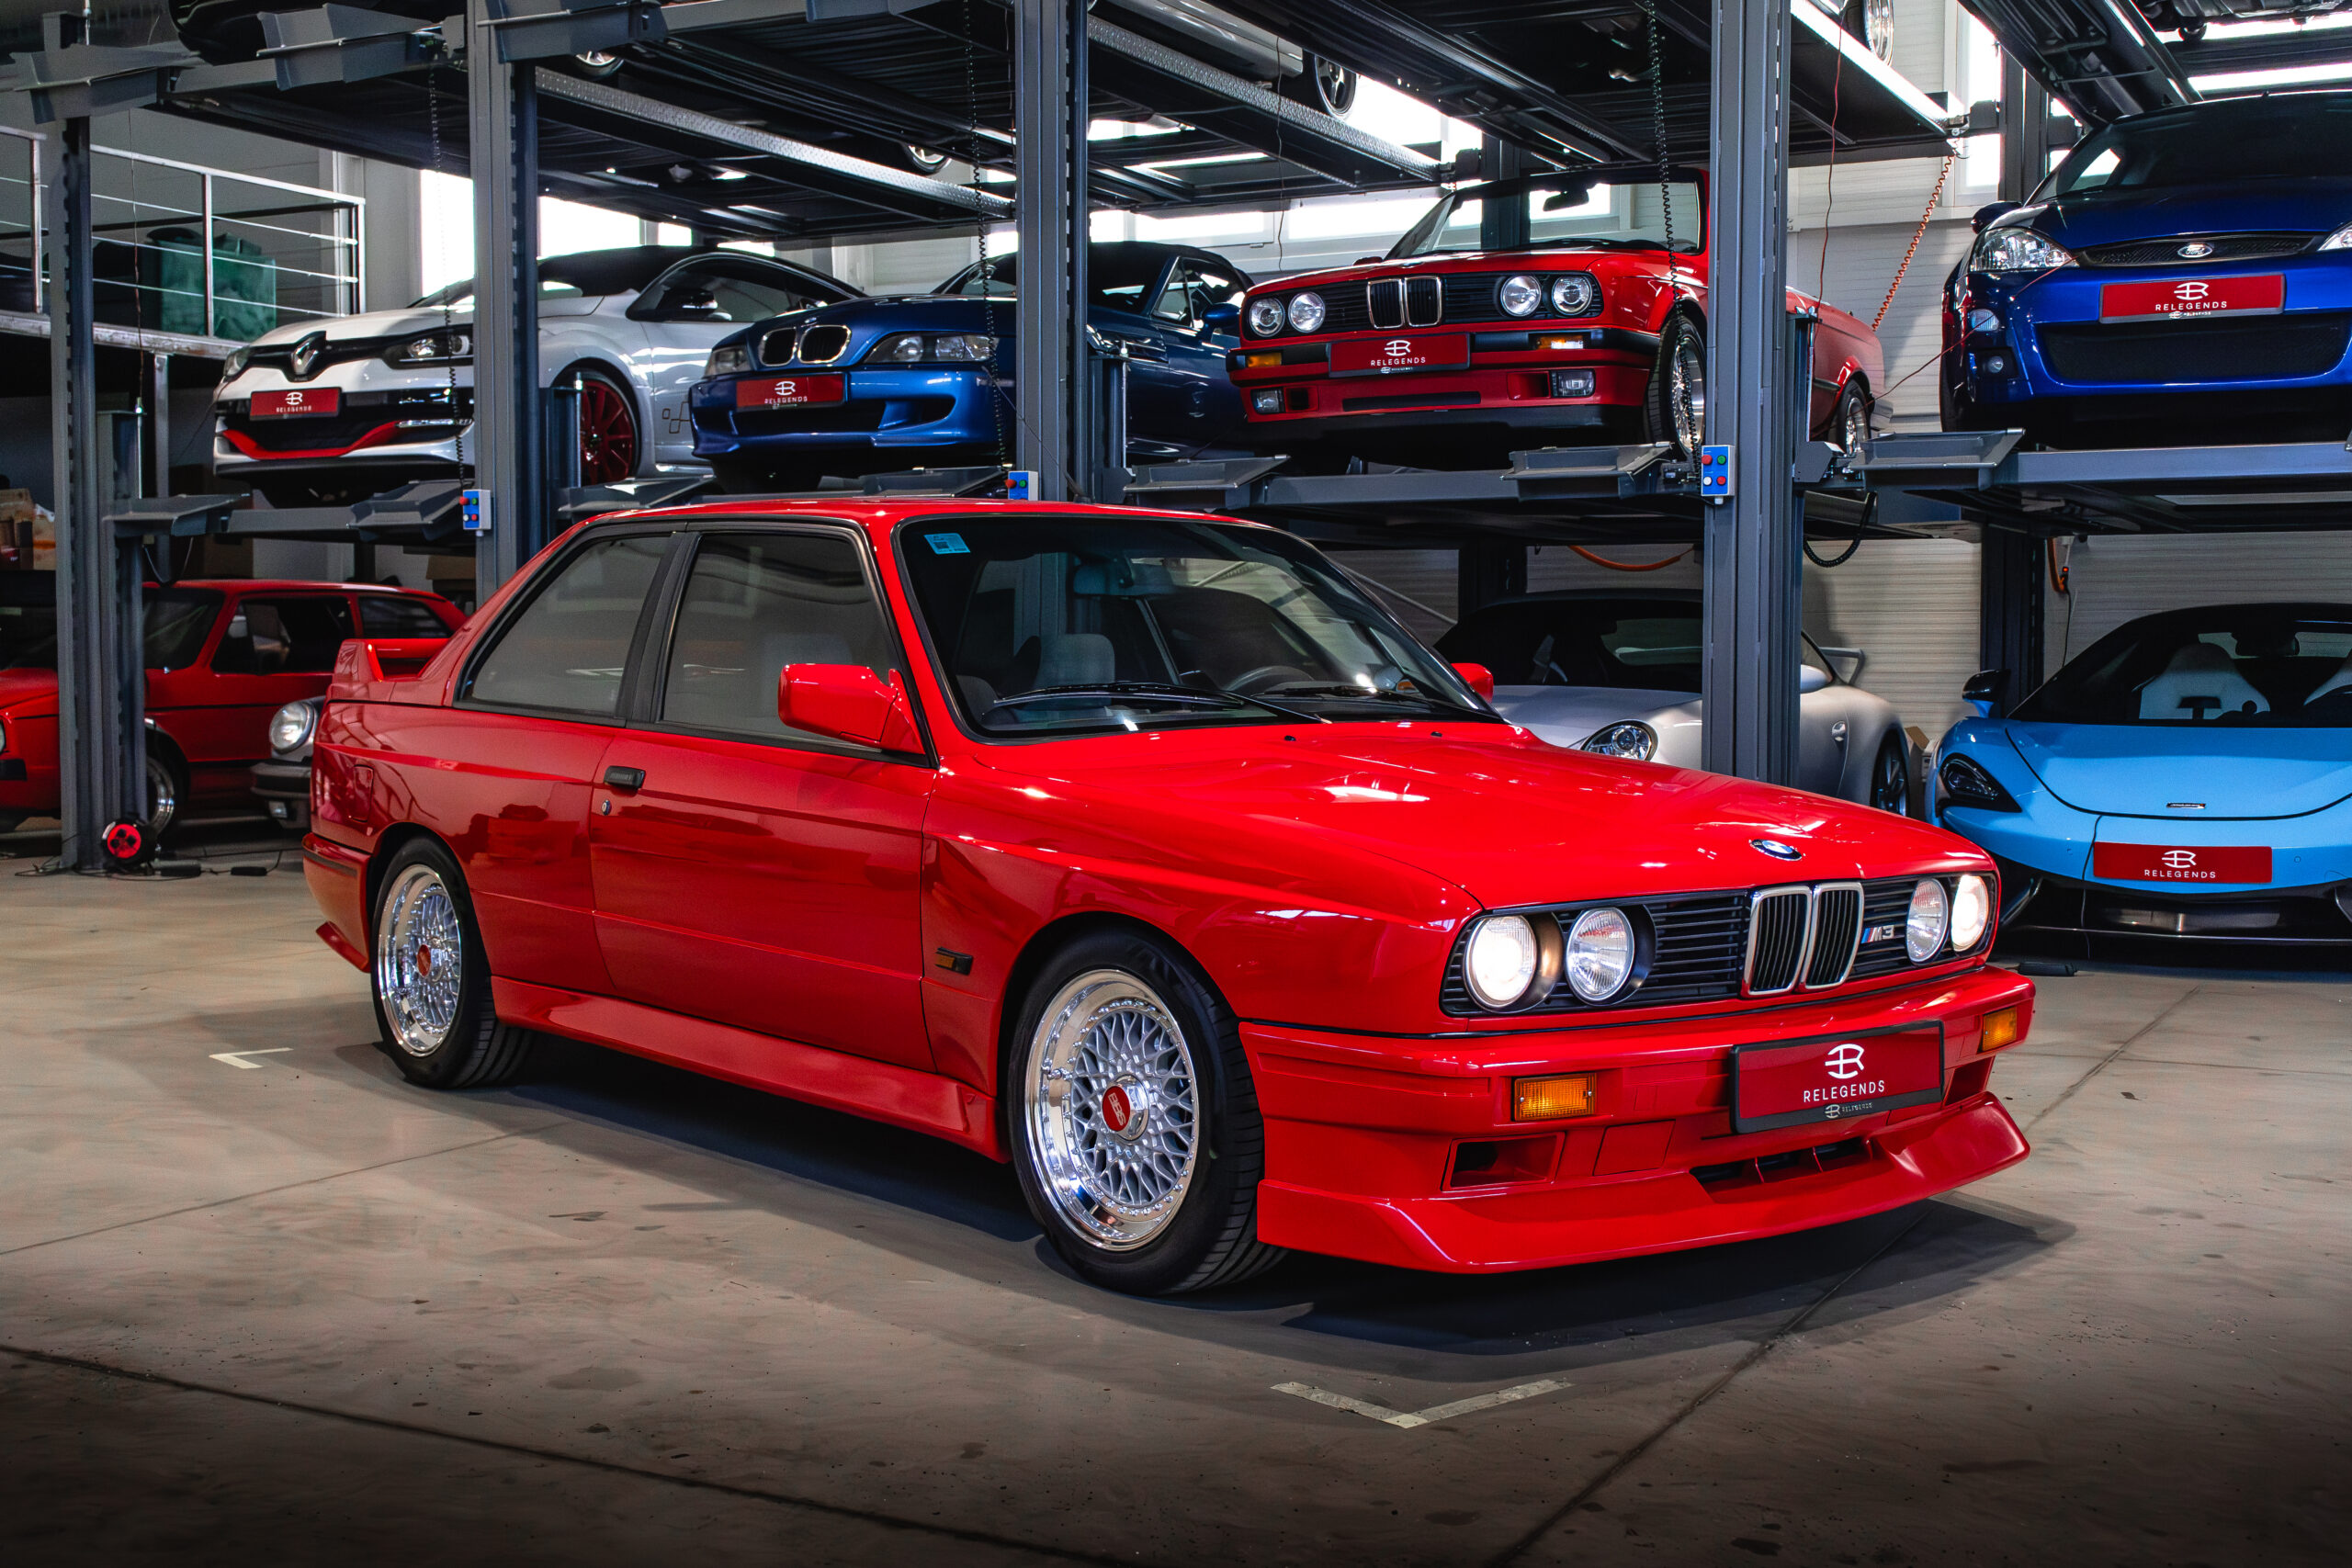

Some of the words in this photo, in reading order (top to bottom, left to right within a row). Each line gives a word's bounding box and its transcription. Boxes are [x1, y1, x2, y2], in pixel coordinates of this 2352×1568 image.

[2155, 301, 2227, 310] RELEGENDS
[1370, 356, 1426, 367] RELEGENDS
[2143, 869, 2216, 879] RELEGENDS
[1804, 1080, 1885, 1102] RELEGENDS
[1108, 1092, 1126, 1126] BBS
